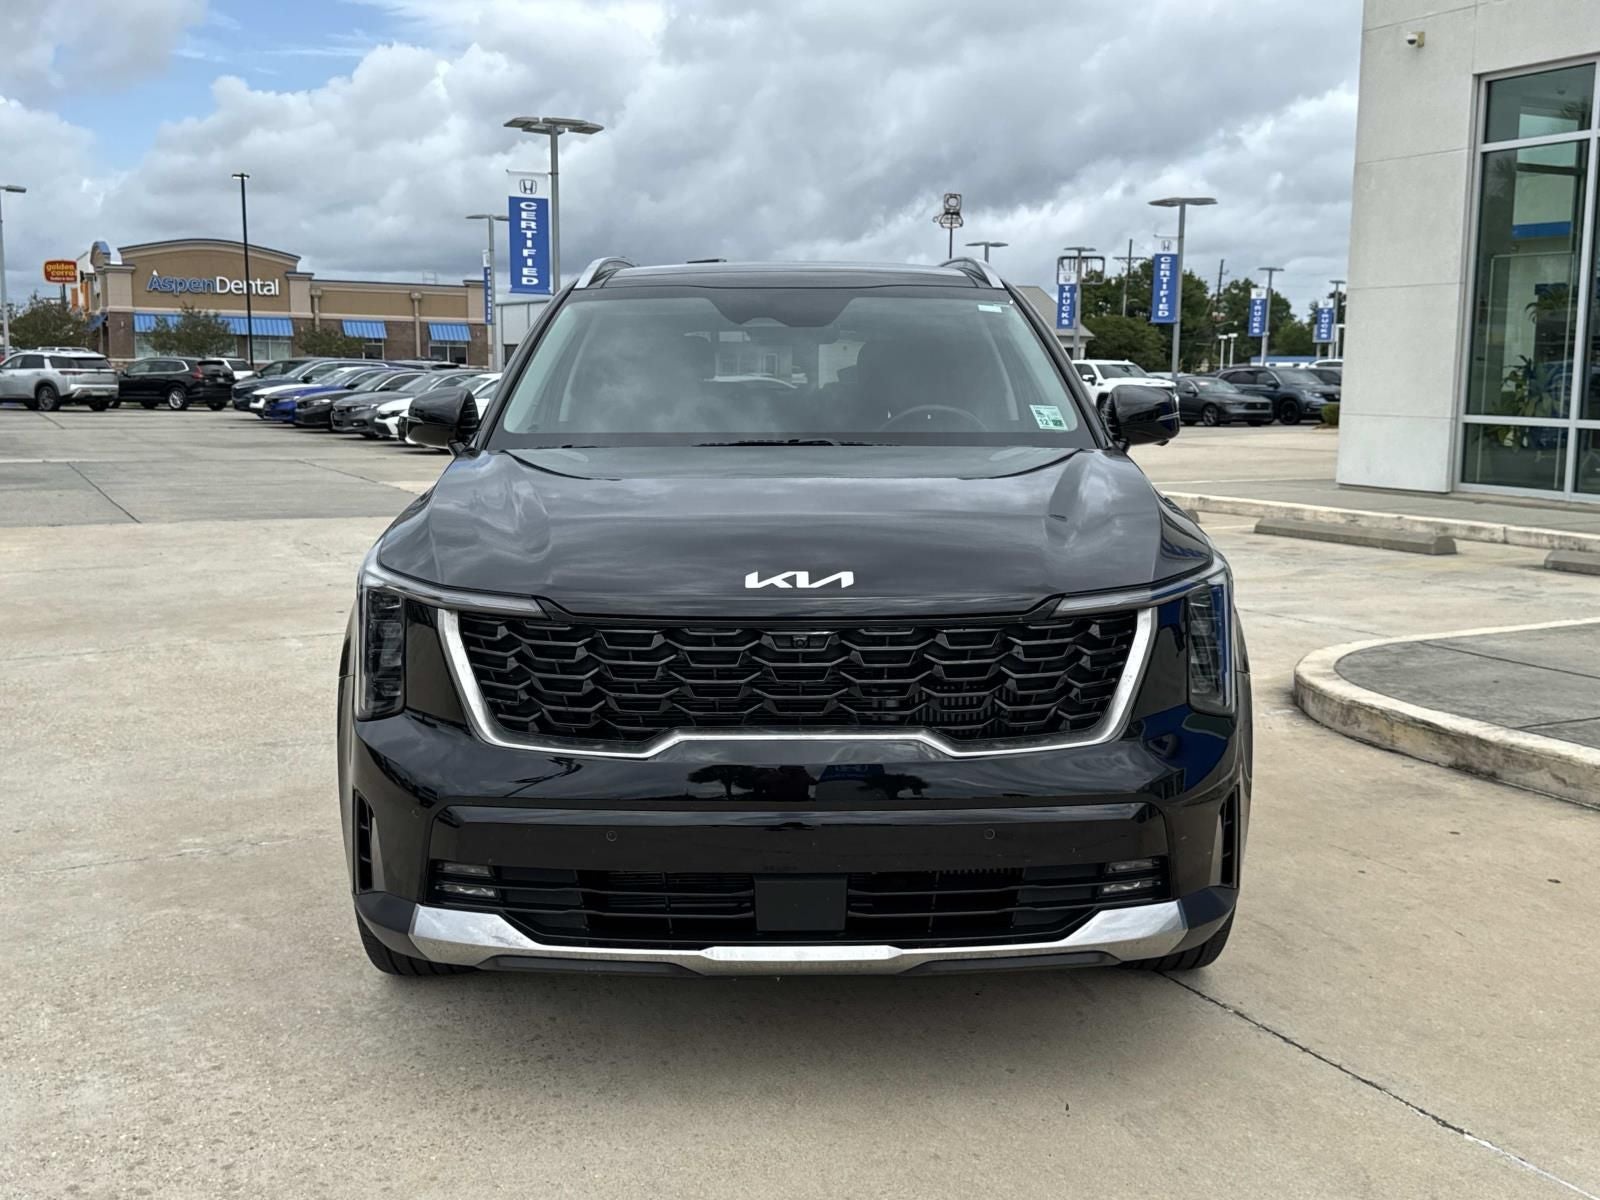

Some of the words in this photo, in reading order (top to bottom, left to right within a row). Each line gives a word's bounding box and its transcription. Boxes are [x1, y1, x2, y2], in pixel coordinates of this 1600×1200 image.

[519, 201, 539, 286] CERTIFIED
[1061, 285, 1071, 326] TRUCKS
[1158, 256, 1172, 317] CERTIFIED
